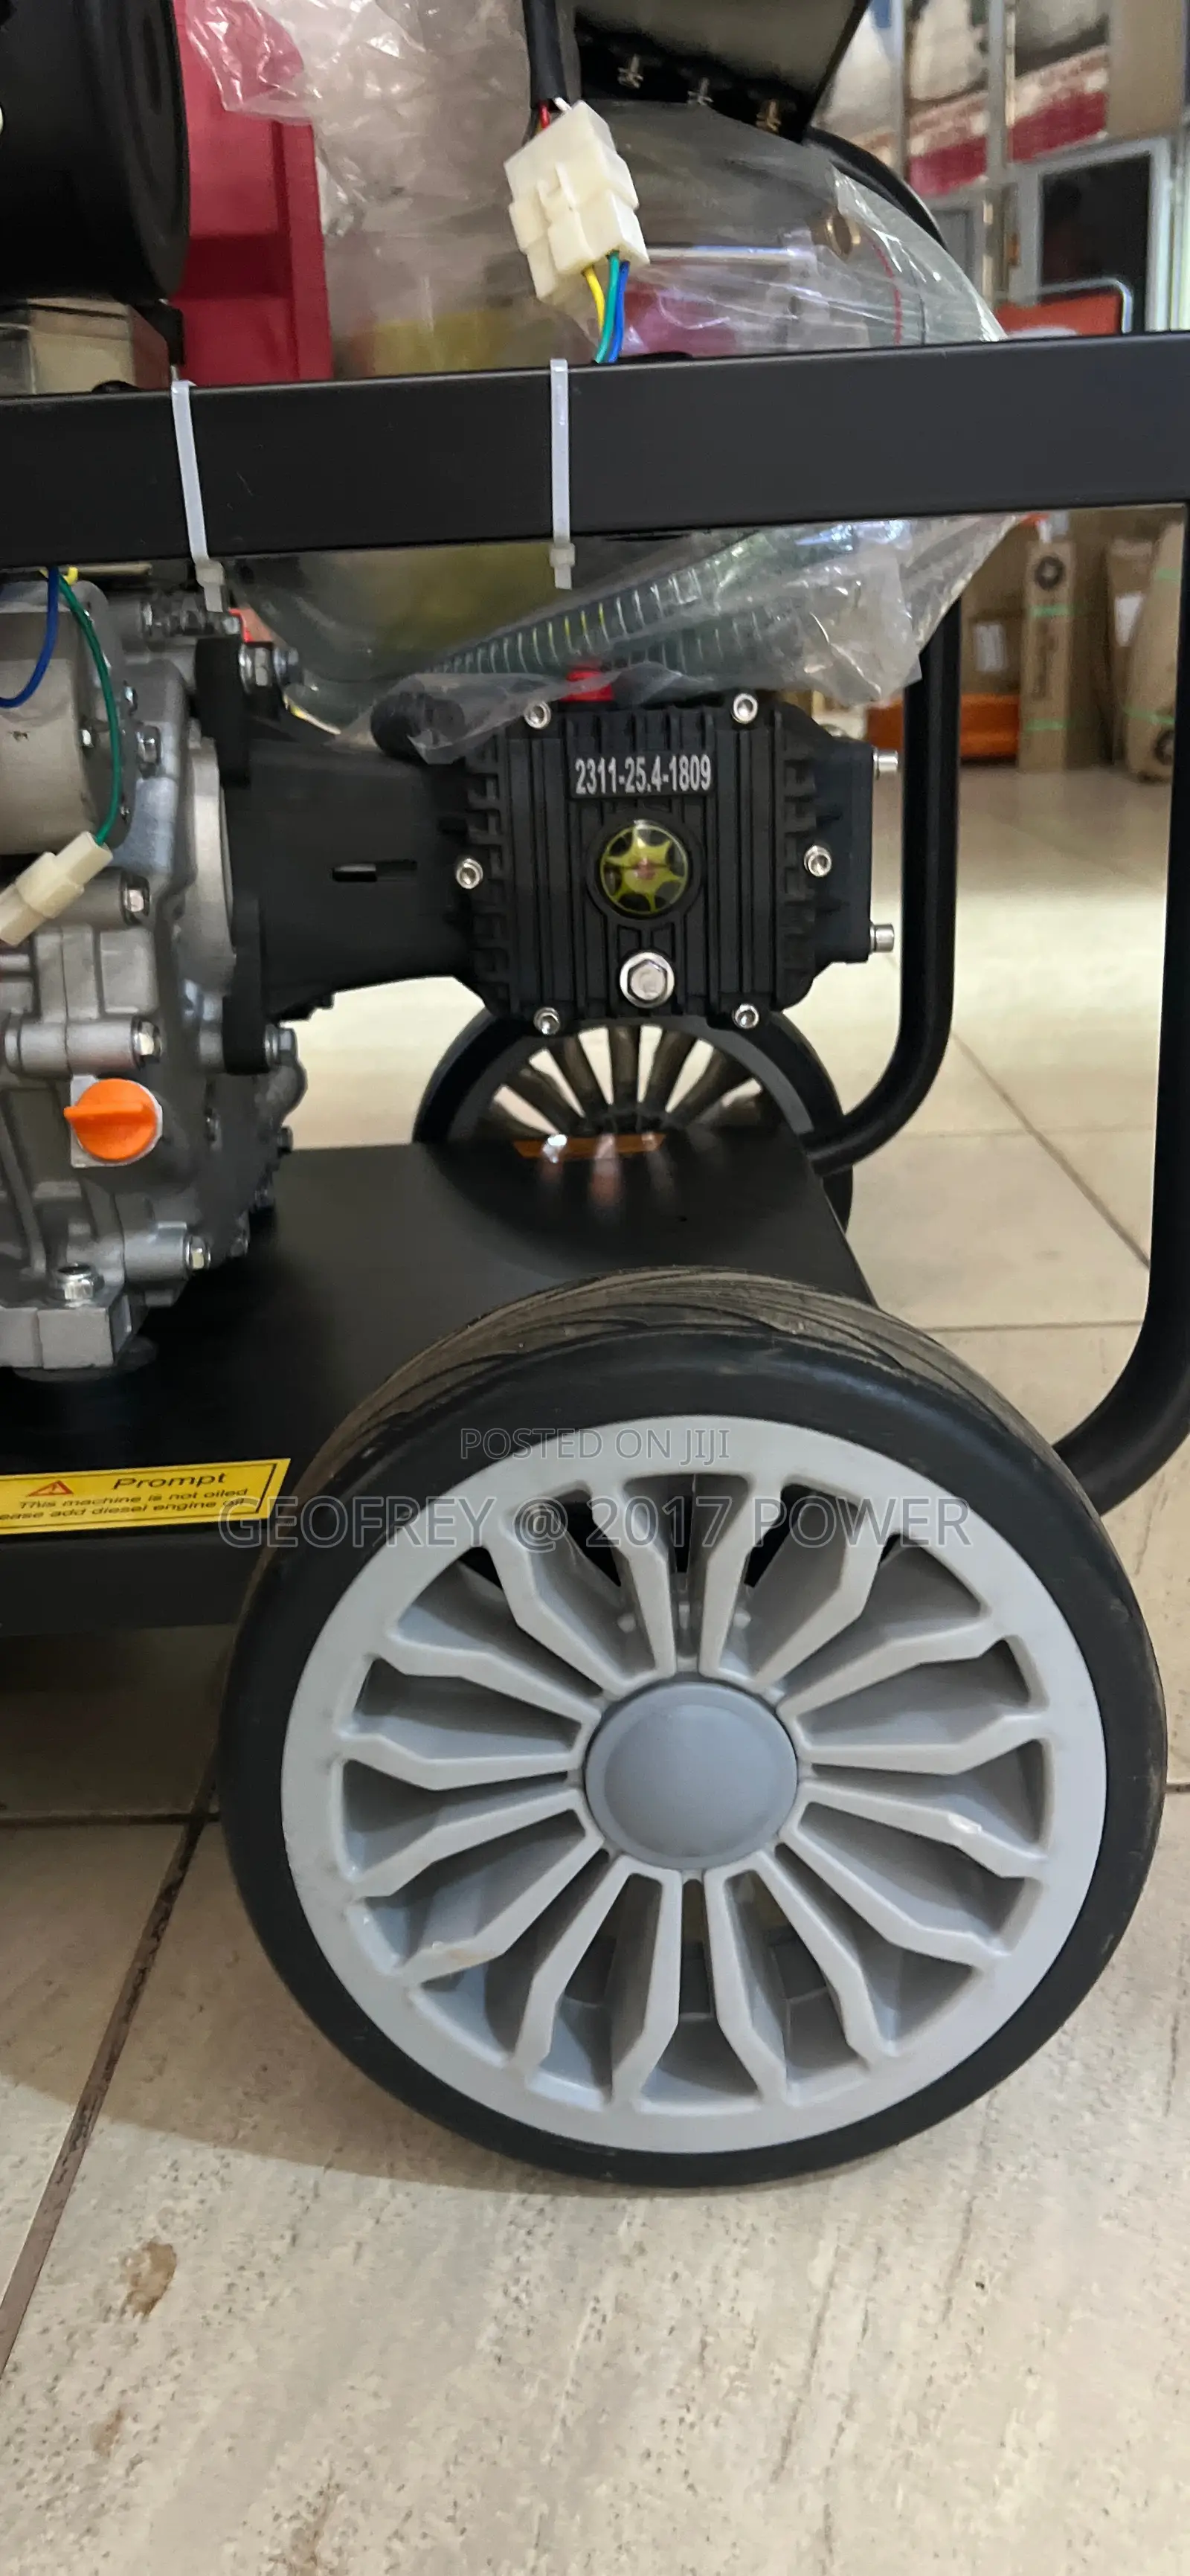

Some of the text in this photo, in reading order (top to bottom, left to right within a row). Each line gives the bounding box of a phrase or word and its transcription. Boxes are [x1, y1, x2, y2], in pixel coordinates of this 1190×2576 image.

[575, 754, 711, 794] 2311-25.4-1809
[112, 1472, 227, 1490] Prompt
[20, 1488, 248, 1509] This machine is not oiled
[0, 1511, 44, 1520] ease
[50, 1509, 86, 1517] add
[91, 1505, 147, 1515] diesel
[153, 1500, 216, 1512] engine
